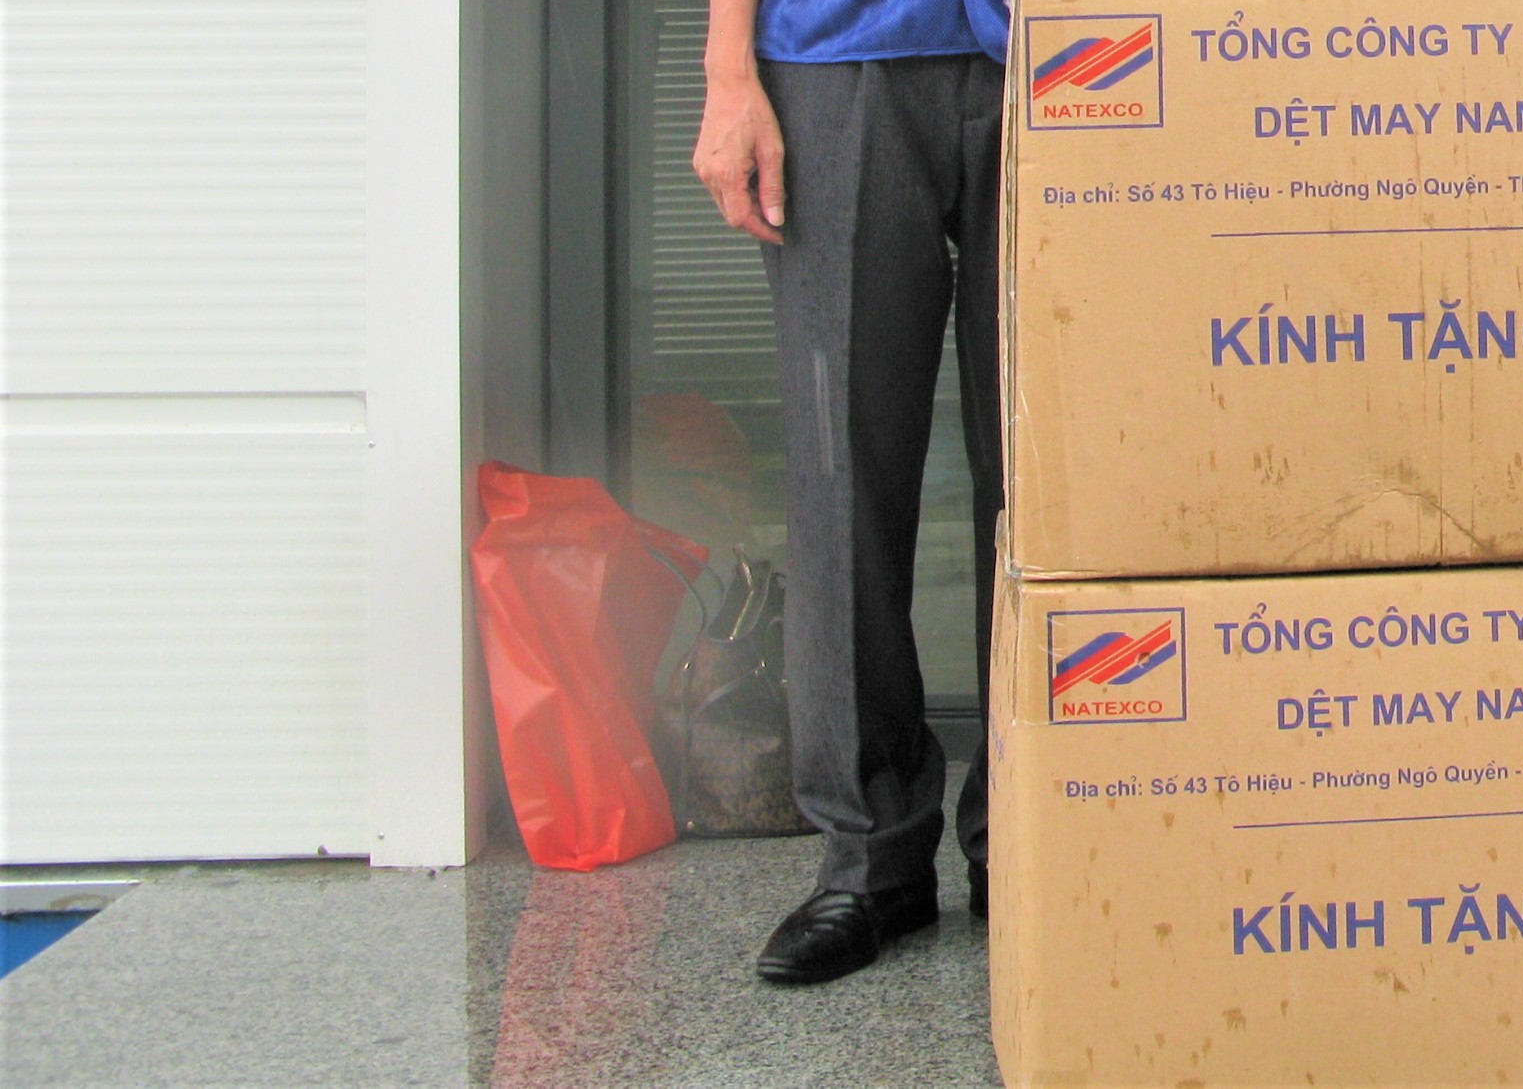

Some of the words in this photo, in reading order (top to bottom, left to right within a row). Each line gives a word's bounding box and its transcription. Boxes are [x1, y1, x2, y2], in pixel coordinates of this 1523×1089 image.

[1191, 9, 1311, 62] TỔNG
[1326, 15, 1449, 58] CÔNG
[1462, 22, 1512, 54] TY
[1043, 103, 1143, 118] NATEXCO
[1254, 95, 1335, 145] DỆT
[1351, 102, 1440, 135] MAY
[1043, 185, 1077, 205] Địa
[1082, 185, 1118, 204] chỉ:
[1126, 184, 1156, 203] Số
[1160, 184, 1185, 201] 43
[1191, 182, 1219, 201] Tô
[1223, 184, 1270, 200] Hiệu
[1289, 179, 1372, 201] Phường
[1376, 179, 1418, 200] Ngô
[1423, 176, 1489, 198] Quyền
[1211, 303, 1365, 366] KÍNH
[1215, 602, 1334, 654] TỔNG
[1348, 605, 1470, 649] CÔNG
[1062, 701, 1163, 715] NATEXCO
[1277, 687, 1358, 737] DỆT
[1372, 690, 1460, 725] MAY
[1065, 780, 1100, 798] Địa
[1105, 775, 1142, 798] chỉ:
[1151, 777, 1180, 796] Số
[1183, 776, 1208, 795] 43
[1215, 774, 1241, 794] Tô
[1246, 775, 1293, 792] Hiệu
[1312, 771, 1391, 790] Phường
[1397, 767, 1440, 789] Ngô
[1443, 762, 1510, 785] Quyền
[1233, 892, 1385, 955] KÍNH
